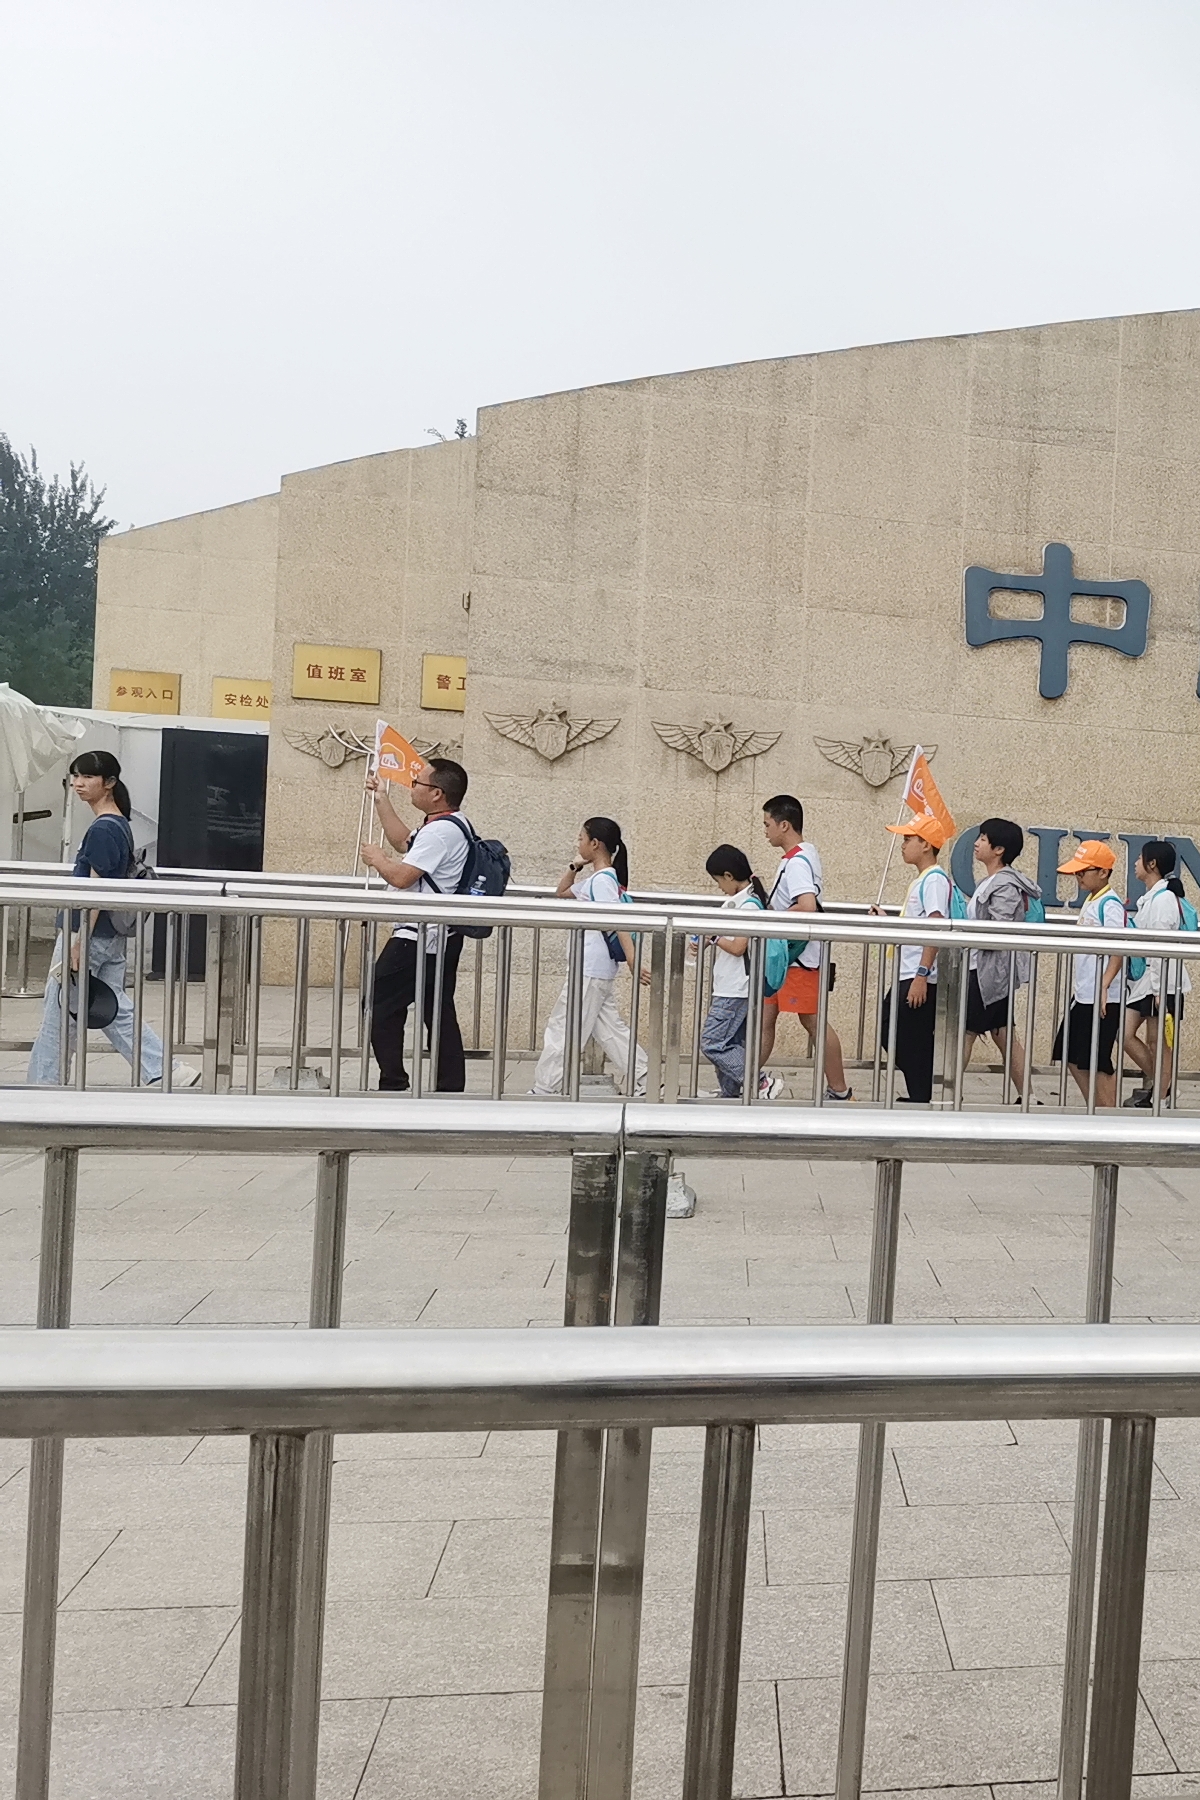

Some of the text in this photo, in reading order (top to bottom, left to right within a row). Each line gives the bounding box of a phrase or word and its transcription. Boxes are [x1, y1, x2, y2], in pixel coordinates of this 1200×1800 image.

[306, 663, 367, 683] 值班室
[116, 685, 174, 701] 参观入口
[224, 693, 269, 709] 安检处
